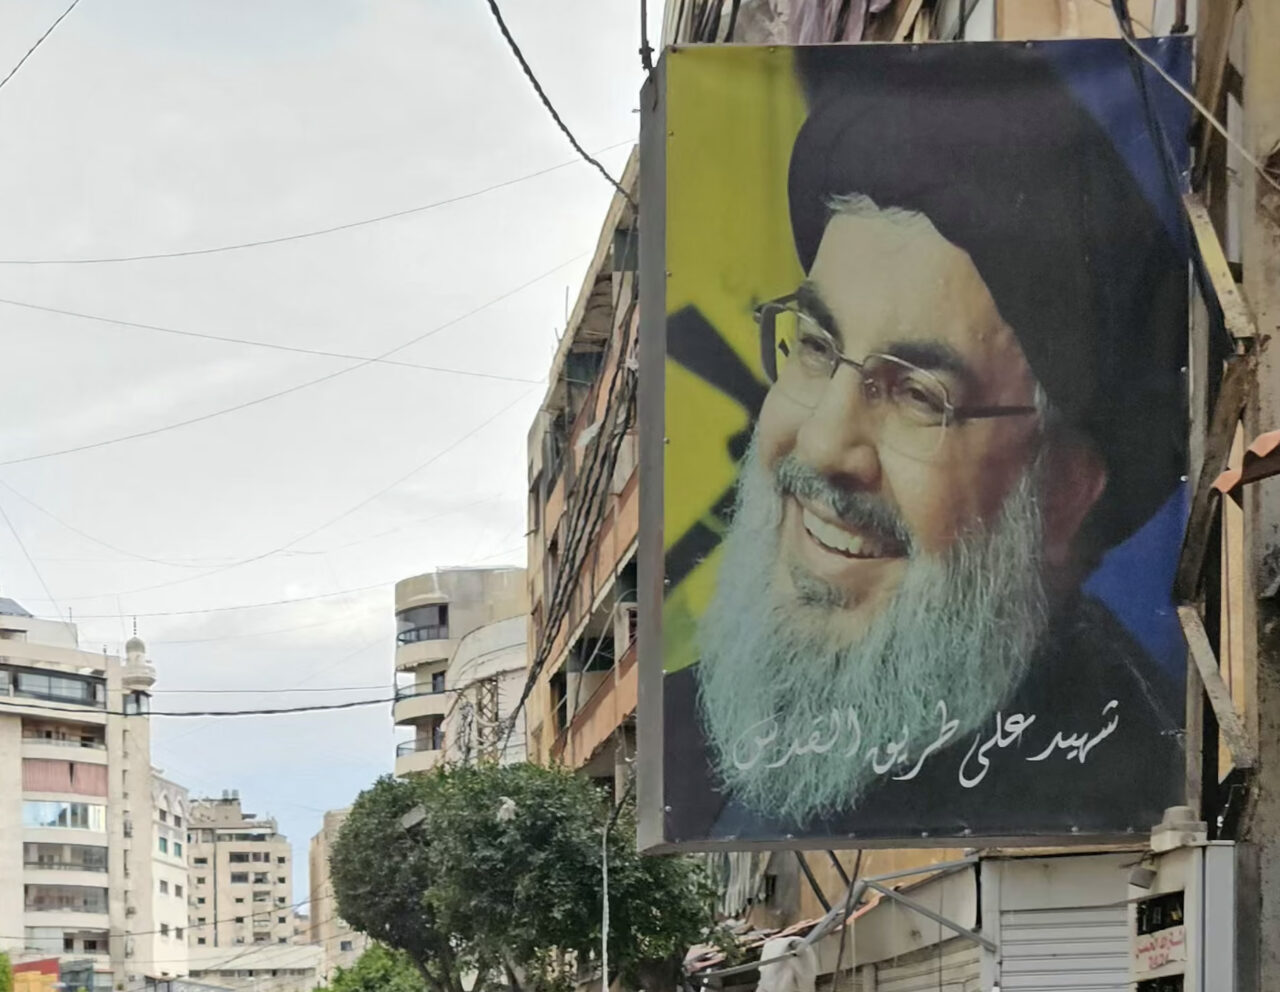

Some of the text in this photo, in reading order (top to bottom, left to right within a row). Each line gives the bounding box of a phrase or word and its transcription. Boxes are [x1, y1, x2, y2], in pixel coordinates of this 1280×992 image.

[732, 699, 1119, 789] شهيد على طريق القدس
